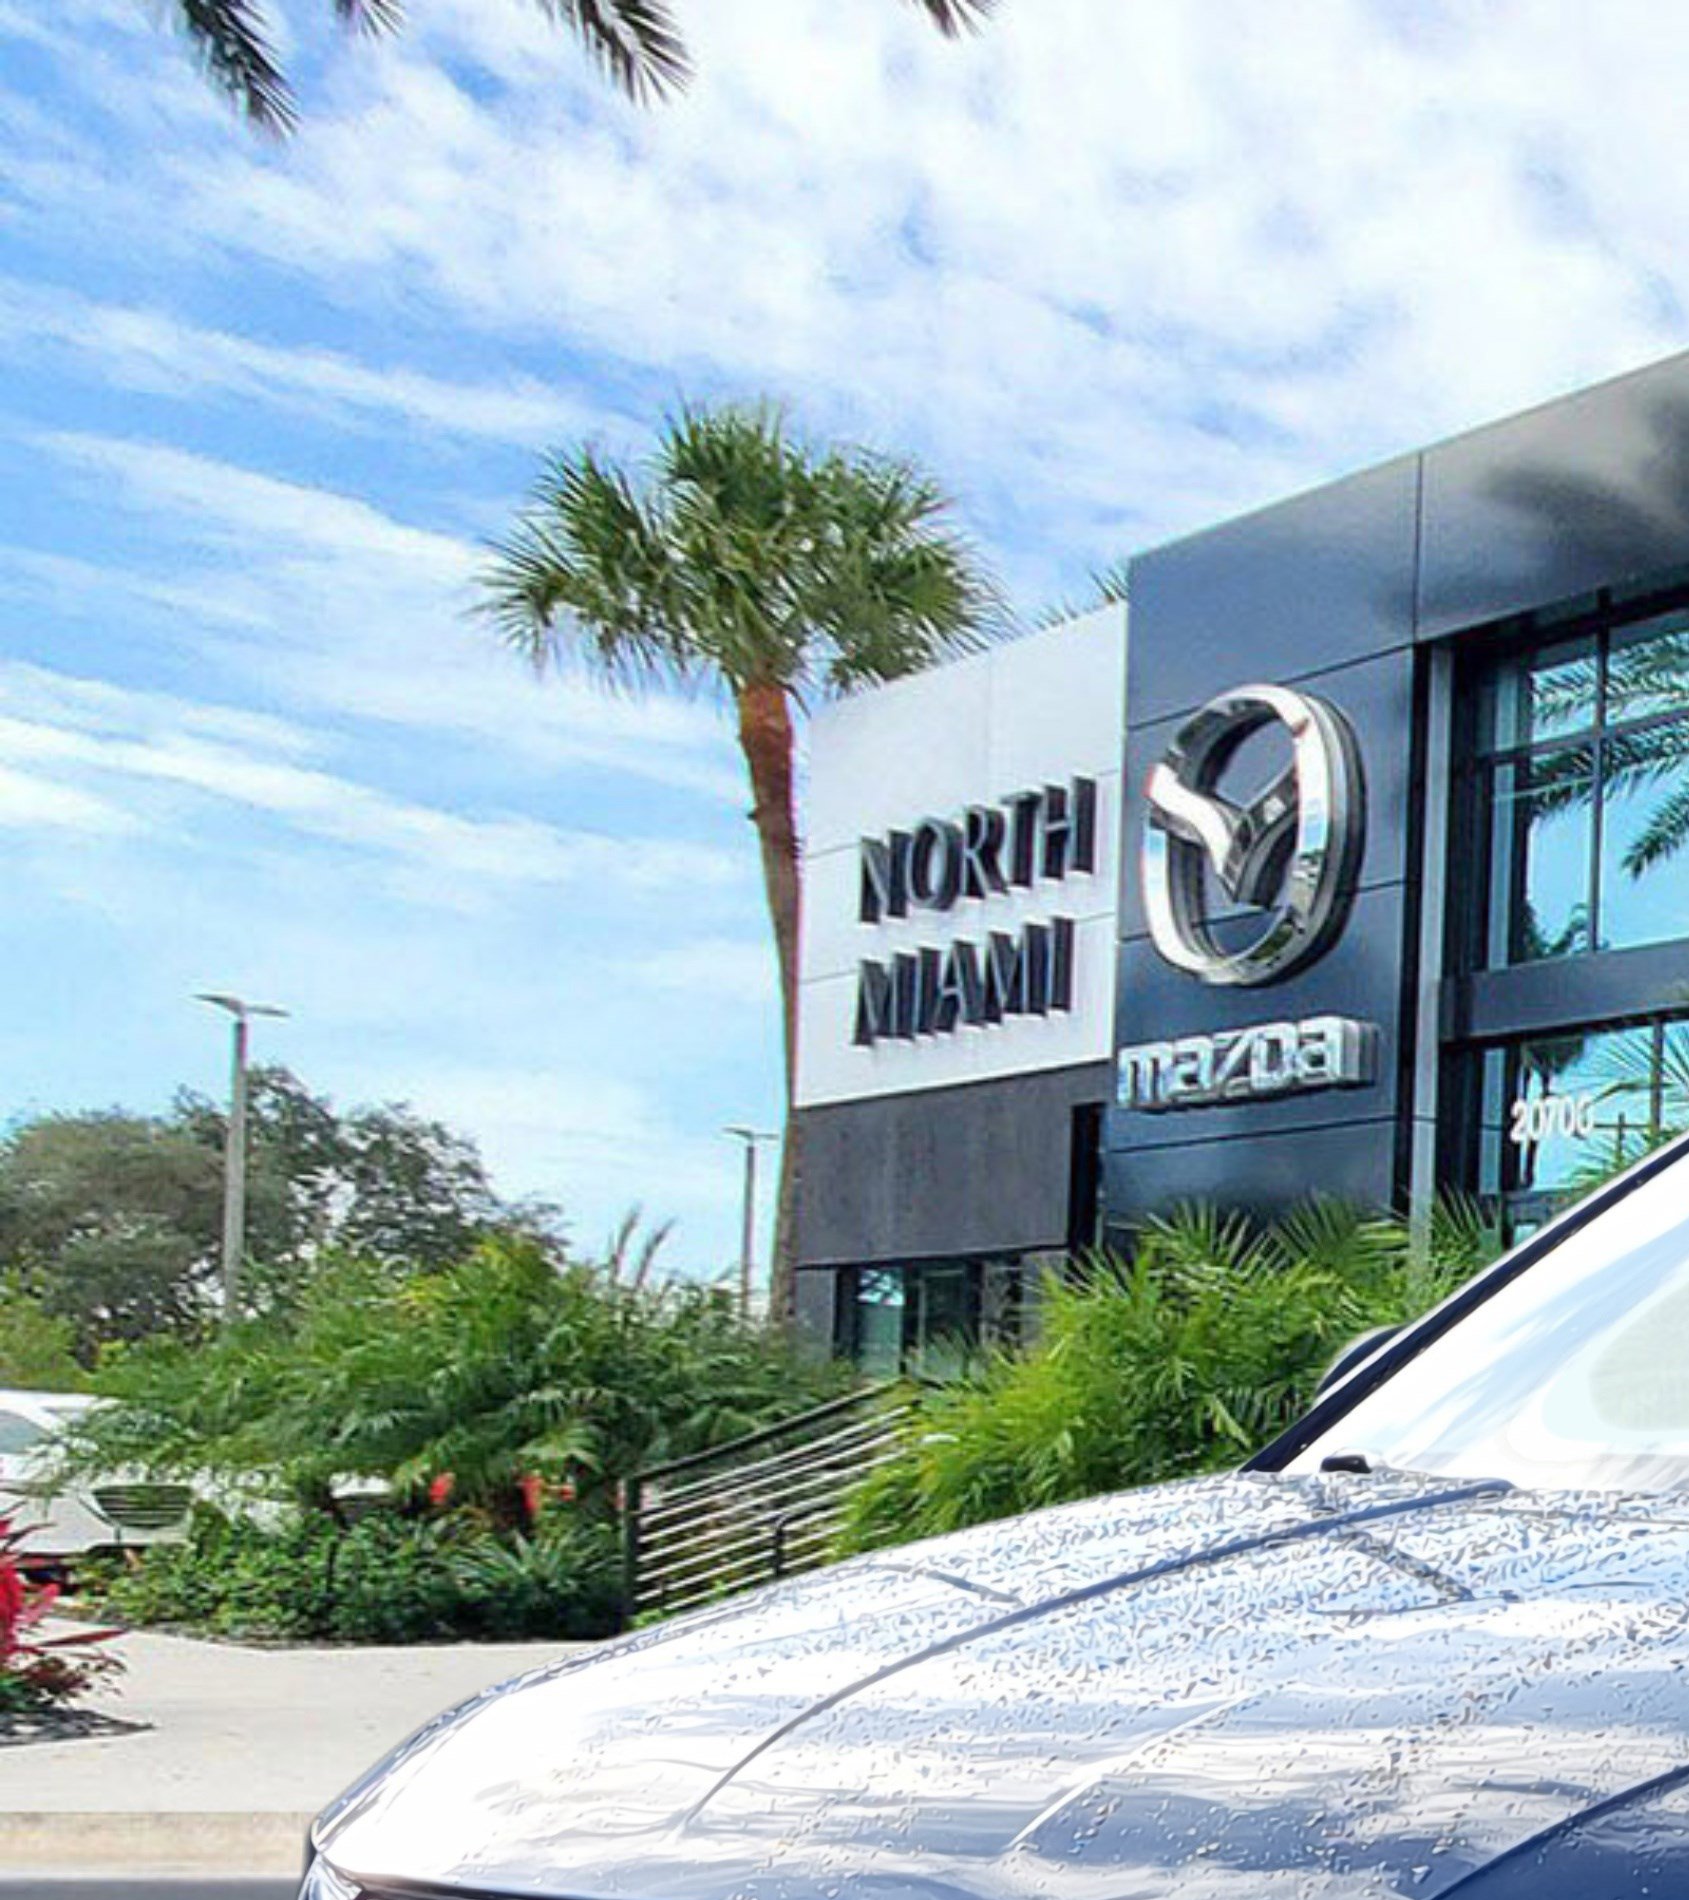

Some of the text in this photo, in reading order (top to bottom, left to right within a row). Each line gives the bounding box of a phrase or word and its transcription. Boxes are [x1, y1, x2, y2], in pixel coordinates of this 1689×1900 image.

[859, 775, 1097, 924] NORTH
[852, 916, 1076, 1046] MIAMI
[1117, 1015, 1374, 1111] mazda
